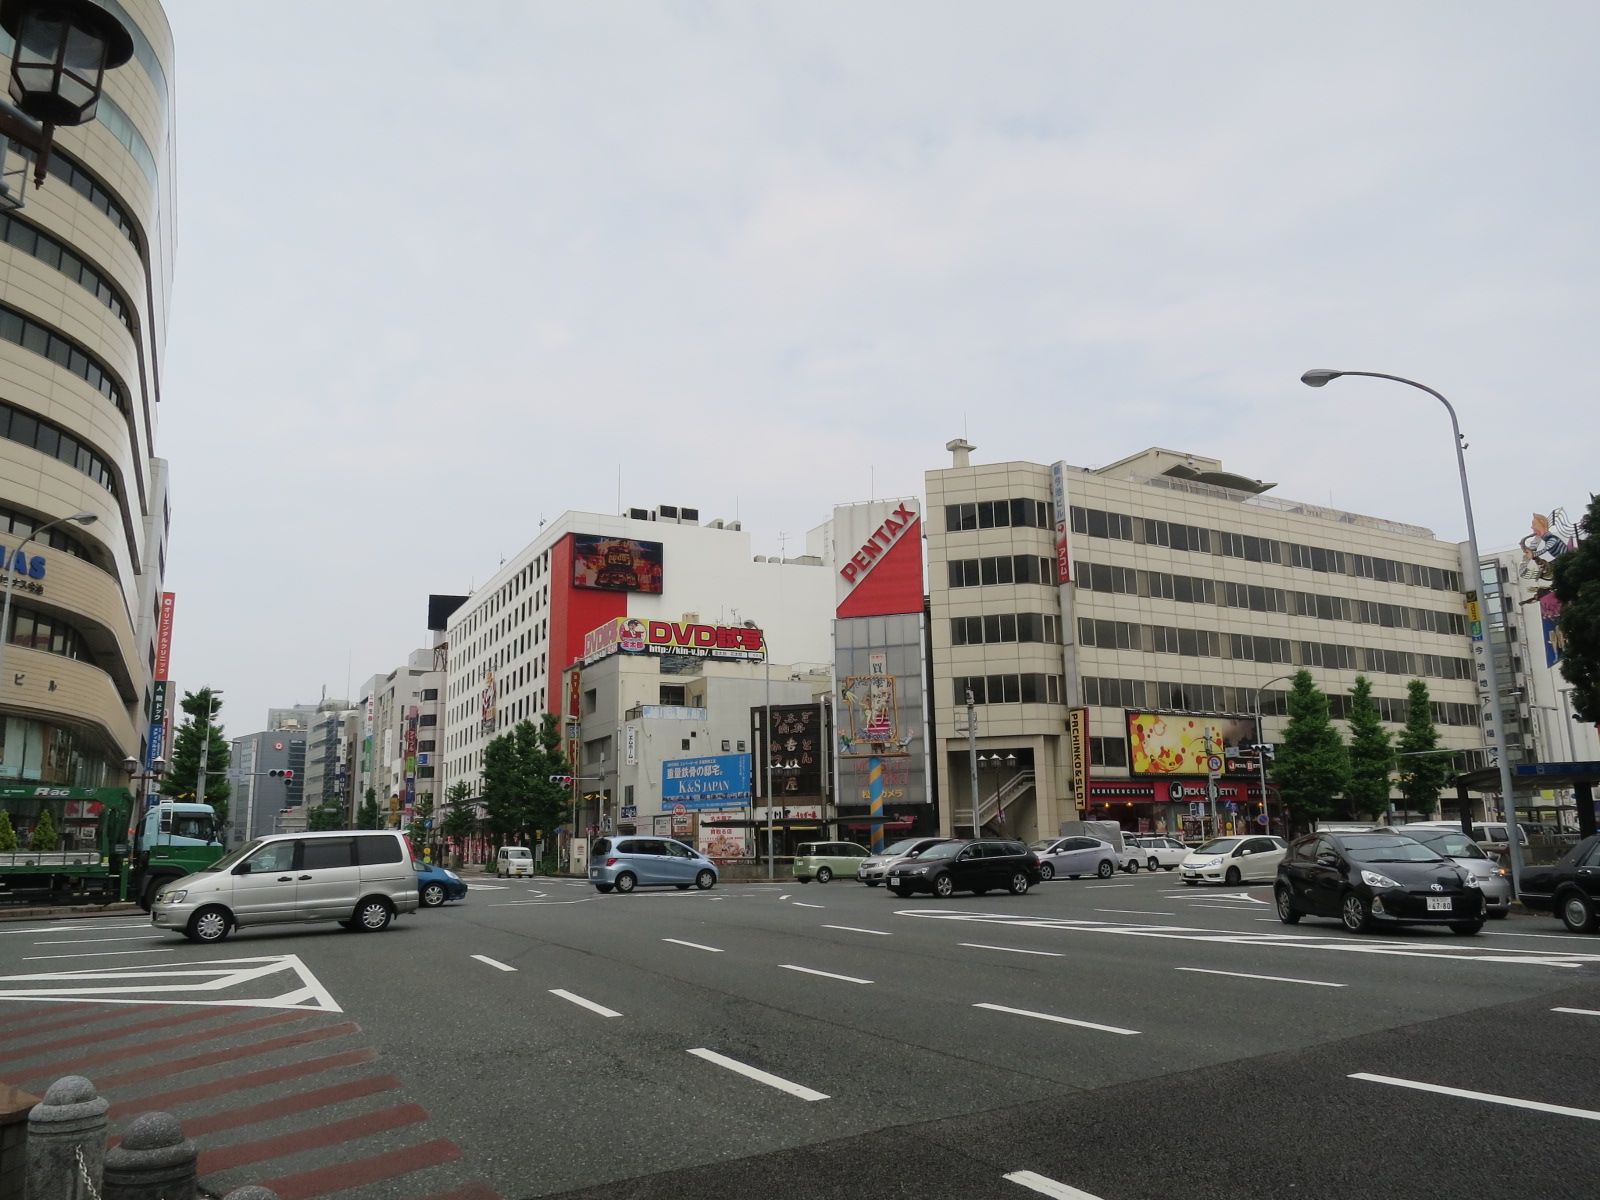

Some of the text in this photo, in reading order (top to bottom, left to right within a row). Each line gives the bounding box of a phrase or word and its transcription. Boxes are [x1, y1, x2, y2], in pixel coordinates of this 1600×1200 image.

[840, 502, 916, 584] PENTAX
[679, 780, 730, 794] K&S JAPAN
[1071, 713, 1084, 807] PACHINKO&SLOT
